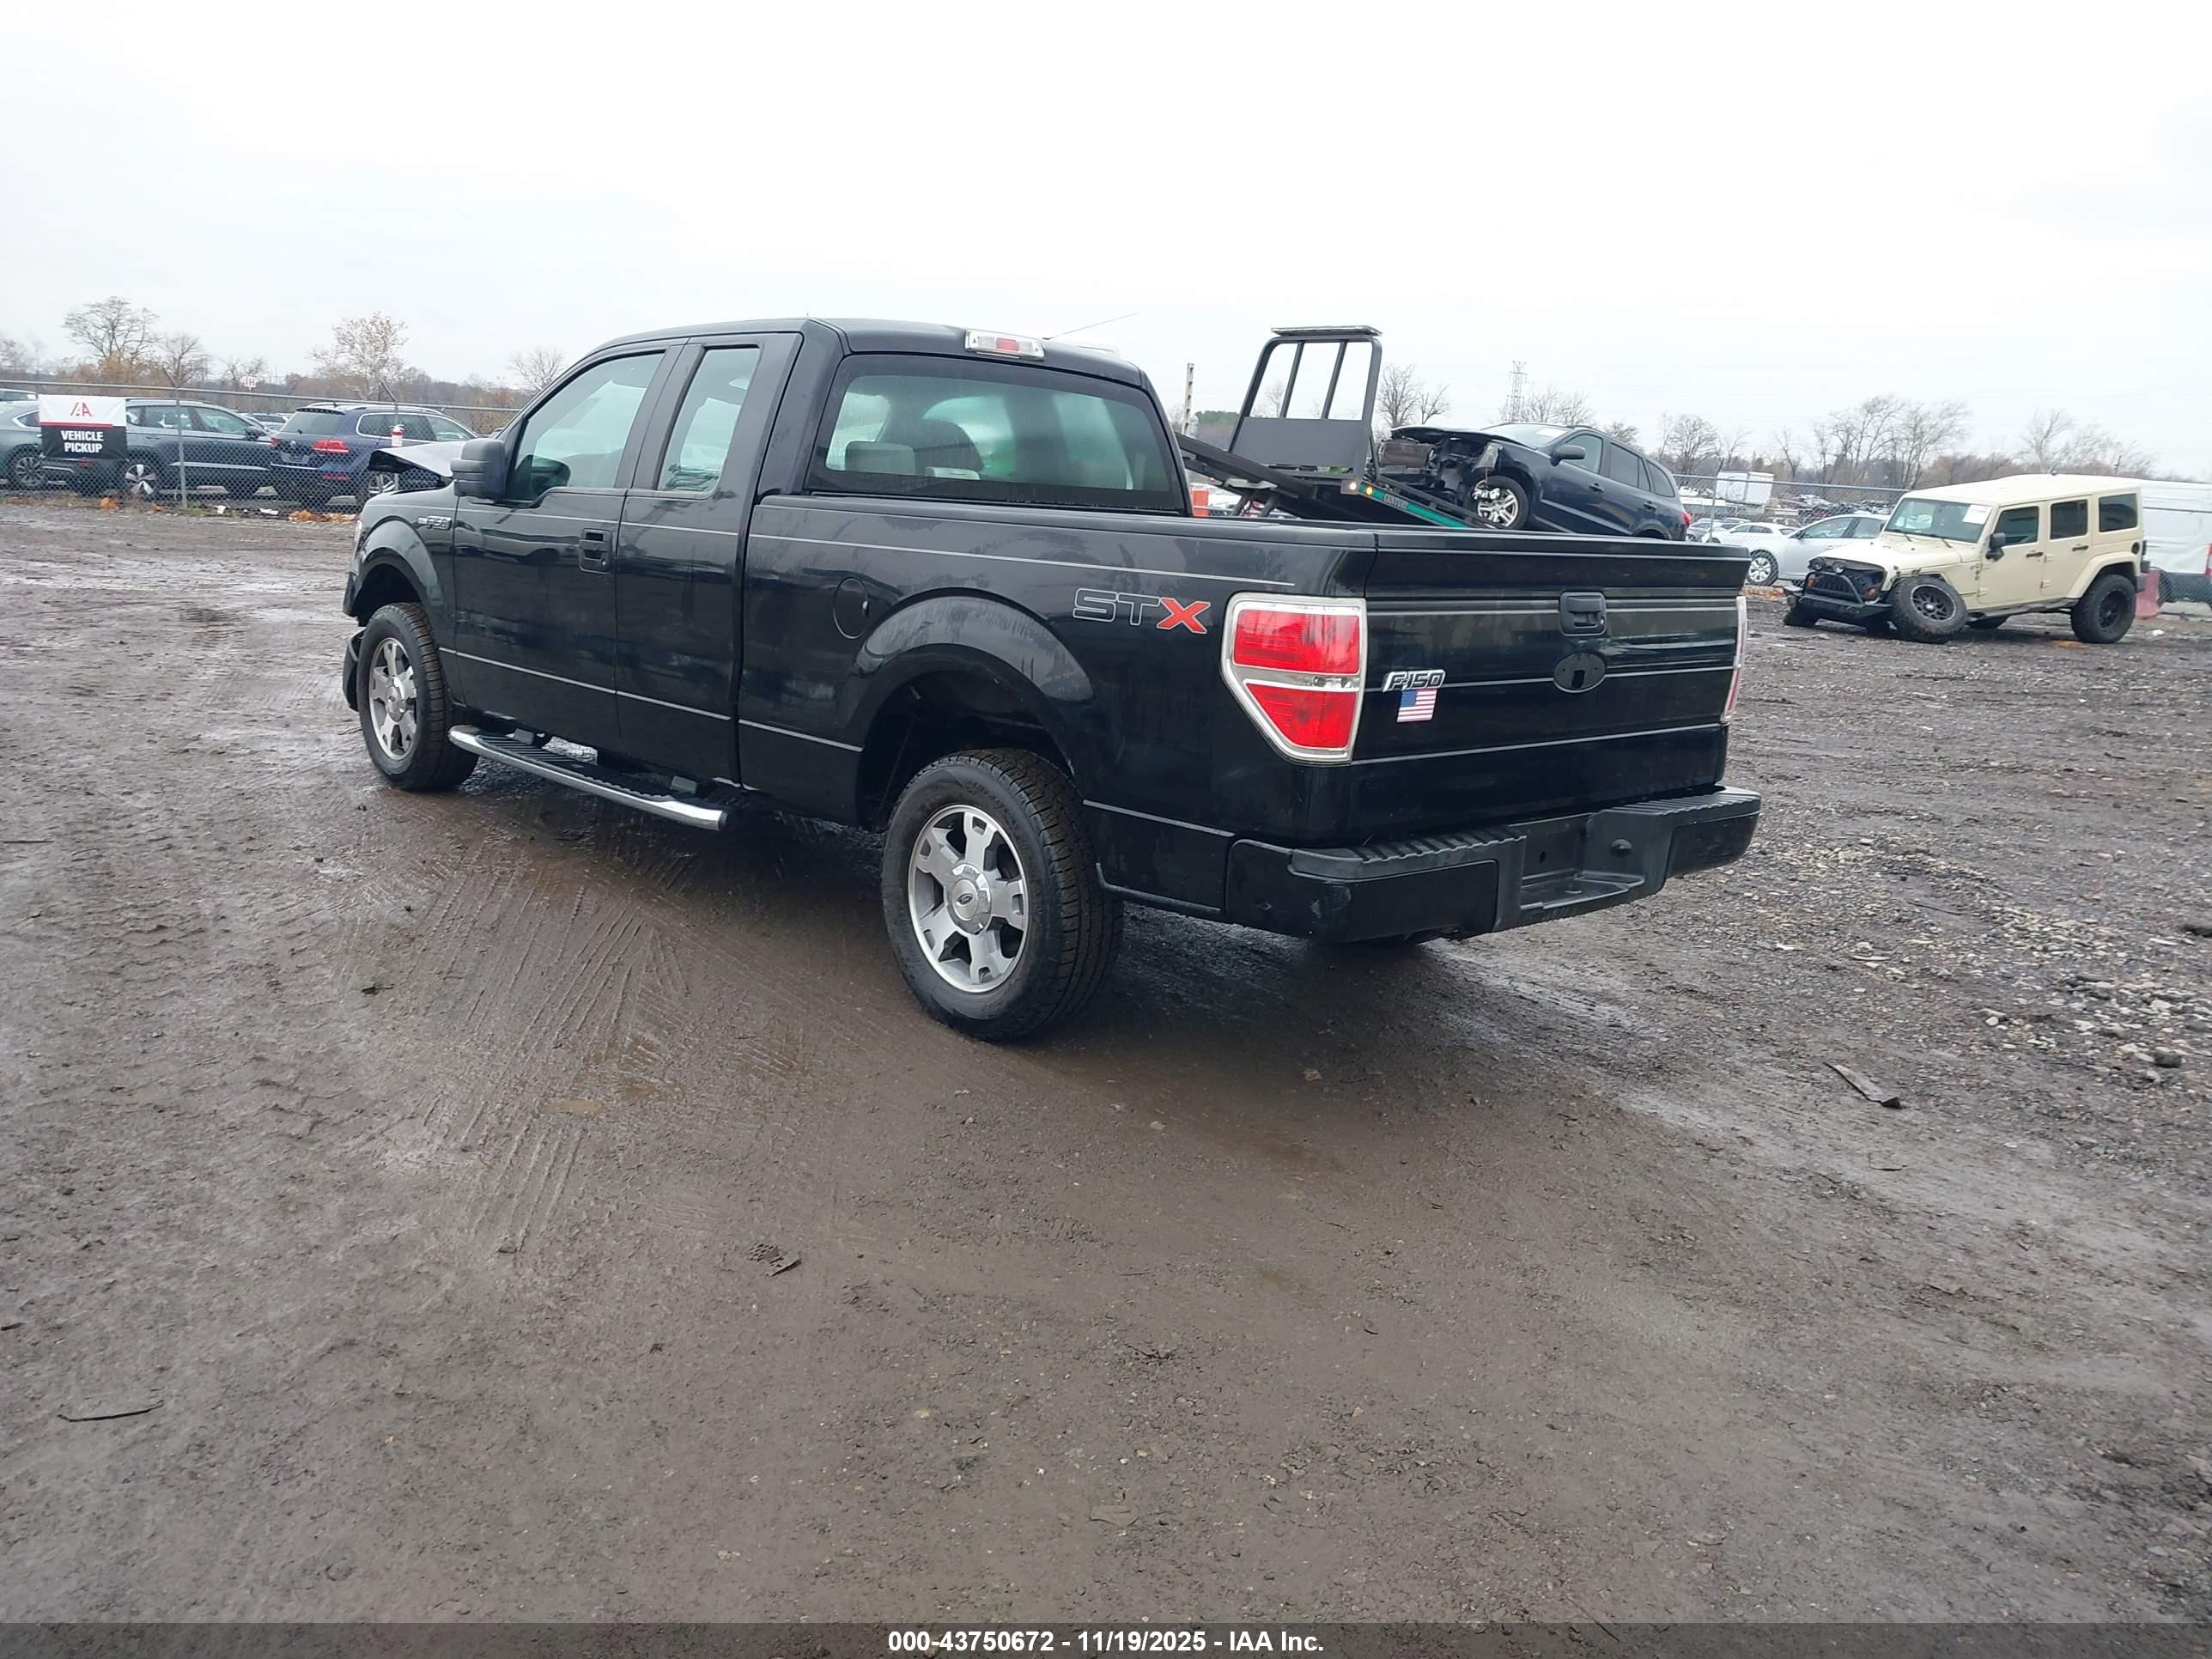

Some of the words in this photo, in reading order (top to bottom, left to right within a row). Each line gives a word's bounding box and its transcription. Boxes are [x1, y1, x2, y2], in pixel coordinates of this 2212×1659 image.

[60, 430, 105, 441] VEHICLE
[64, 442, 103, 453] PICKUP
[1073, 587, 1211, 635] STX
